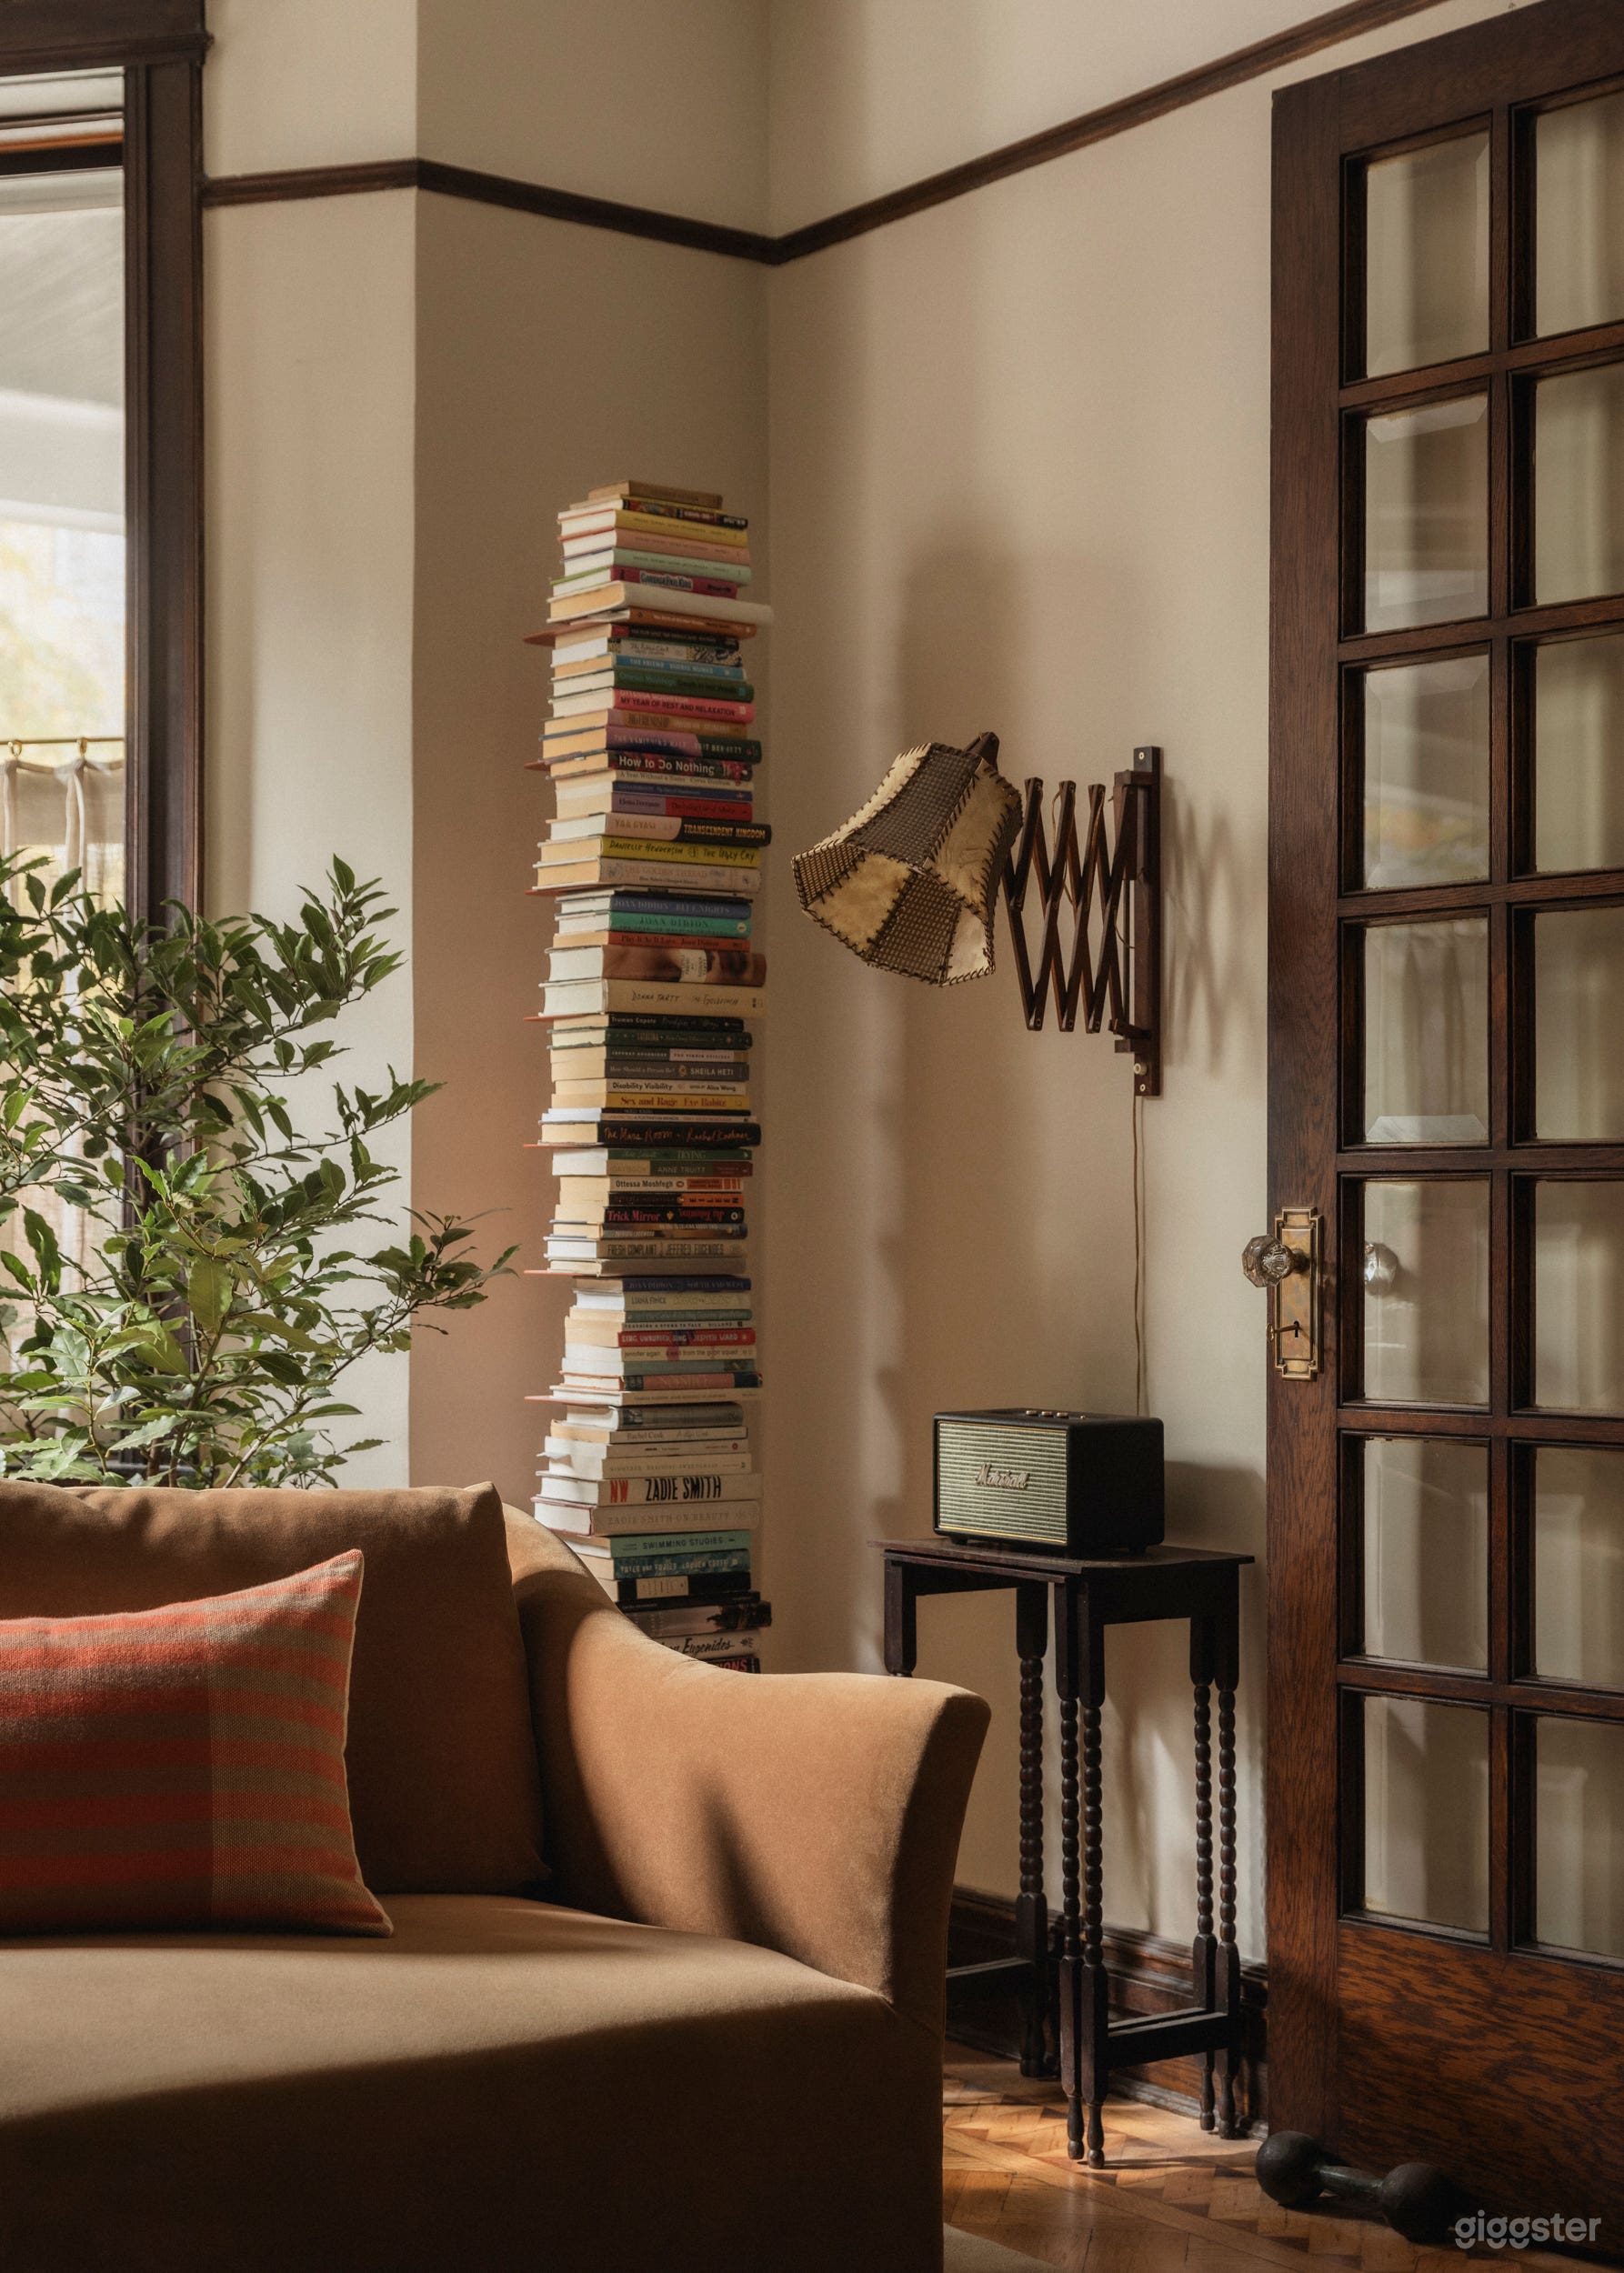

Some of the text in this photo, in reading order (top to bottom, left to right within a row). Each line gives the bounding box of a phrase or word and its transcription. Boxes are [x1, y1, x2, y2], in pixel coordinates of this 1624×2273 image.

[633, 698, 649, 706] YEAR
[681, 704, 693, 712] AND
[695, 706, 736, 716] RELAXATION
[619, 755, 715, 776] How to Do Nothing
[684, 824, 766, 839] TRANSCENDENT KINGDOM
[609, 837, 683, 854] DANIELLE HENDERSON
[614, 900, 635, 908] JOAN
[637, 900, 669, 910] DIDION
[640, 916, 708, 928] JOAN DIDION
[636, 1017, 657, 1026] Capote
[612, 1082, 643, 1090] Disability
[645, 1082, 673, 1091] Visibility
[656, 1097, 677, 1107] Rage
[701, 1097, 726, 1106] Babitz
[642, 1181, 674, 1190] Moshfegh
[607, 1210, 661, 1222] Trick Mirror
[607, 1244, 657, 1255] FRESH COMPLAINT
[673, 1334, 687, 1342] SING
[719, 1332, 737, 1341] WARD
[975, 1462, 1029, 1489] Marshall
[610, 1480, 628, 1503] NW
[645, 1477, 721, 1501] ZADIE SMITH
[608, 1511, 728, 1526] ZADIE SMITH ON BEAUTY
[642, 1539, 687, 1550] SWIMMING
[689, 1537, 724, 1547] STUDIES
[682, 1637, 735, 1658] Eugenides
